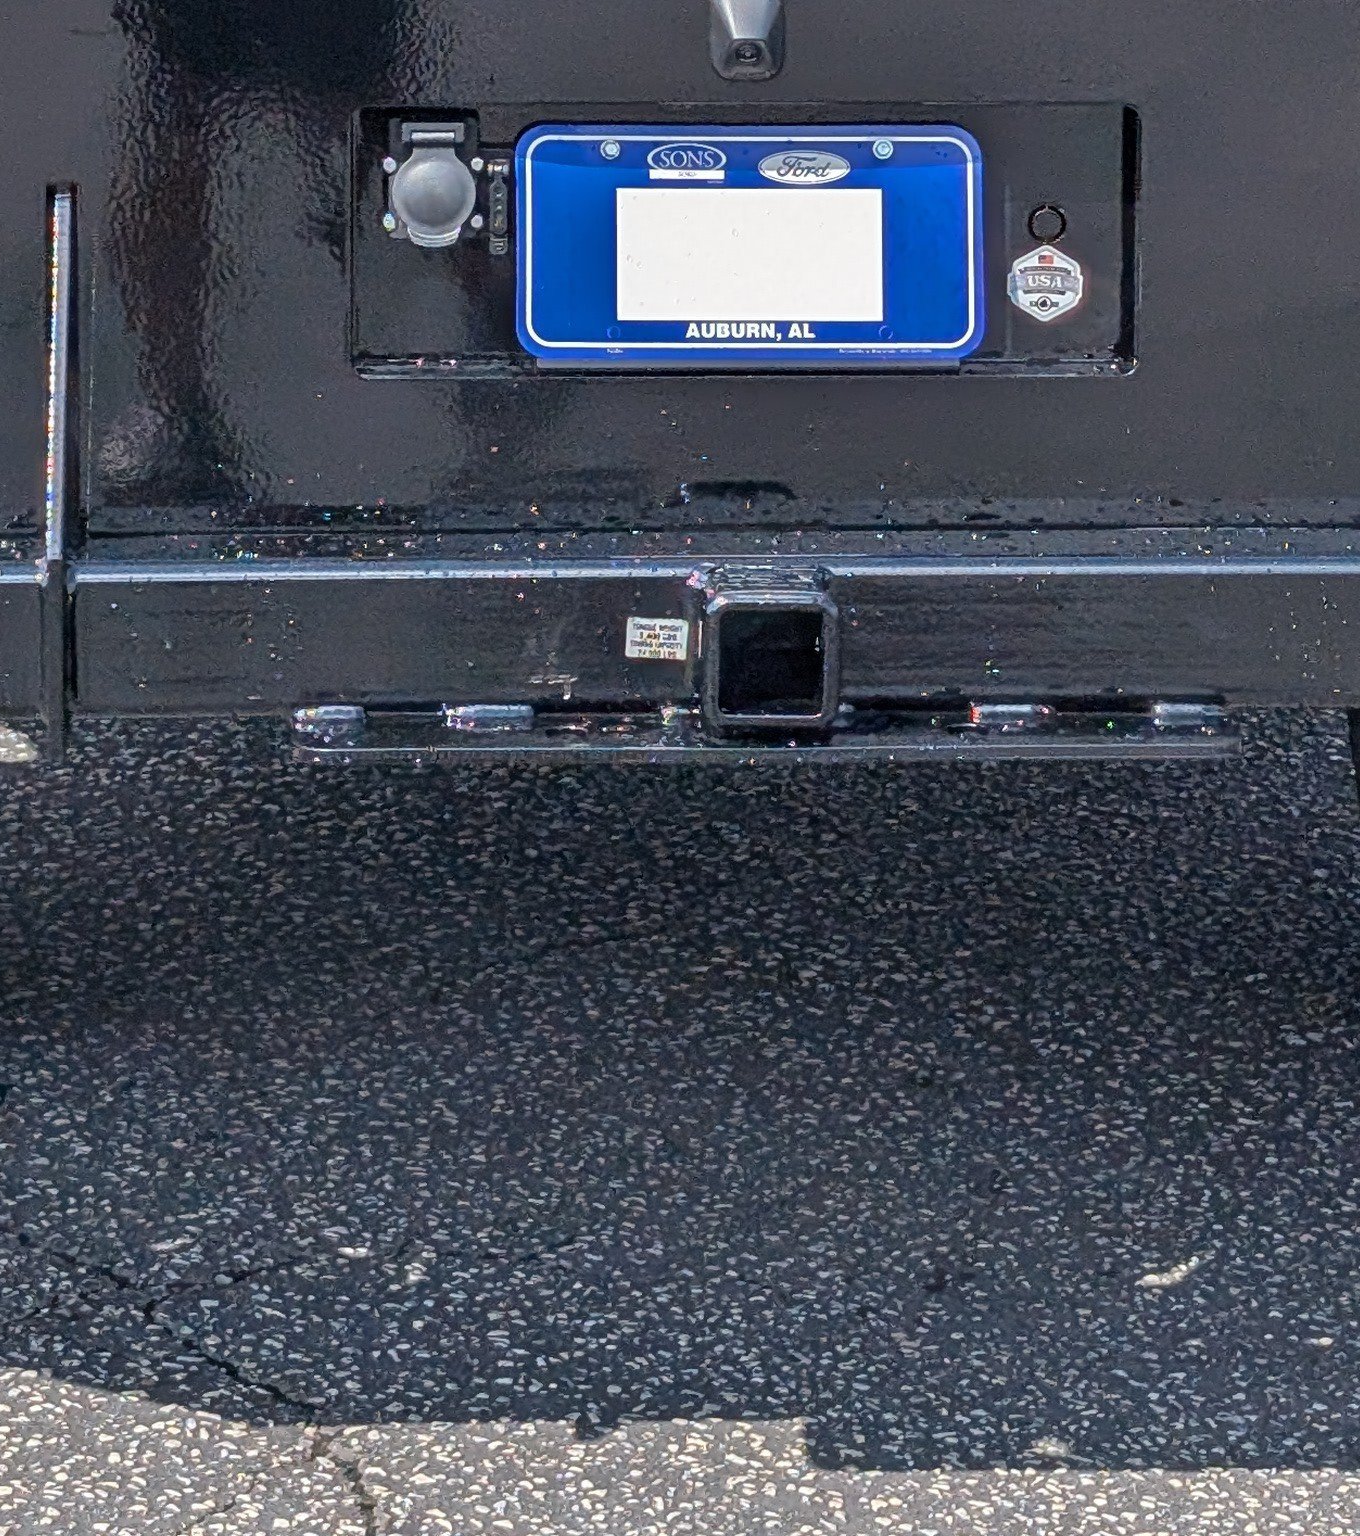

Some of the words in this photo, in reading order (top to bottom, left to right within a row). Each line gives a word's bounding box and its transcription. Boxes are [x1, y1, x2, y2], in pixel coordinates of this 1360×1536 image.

[659, 149, 715, 168] SONS
[776, 155, 831, 178] Ford
[1027, 274, 1063, 288] USA
[685, 322, 783, 342] AUBURN,
[787, 322, 817, 340] AL
